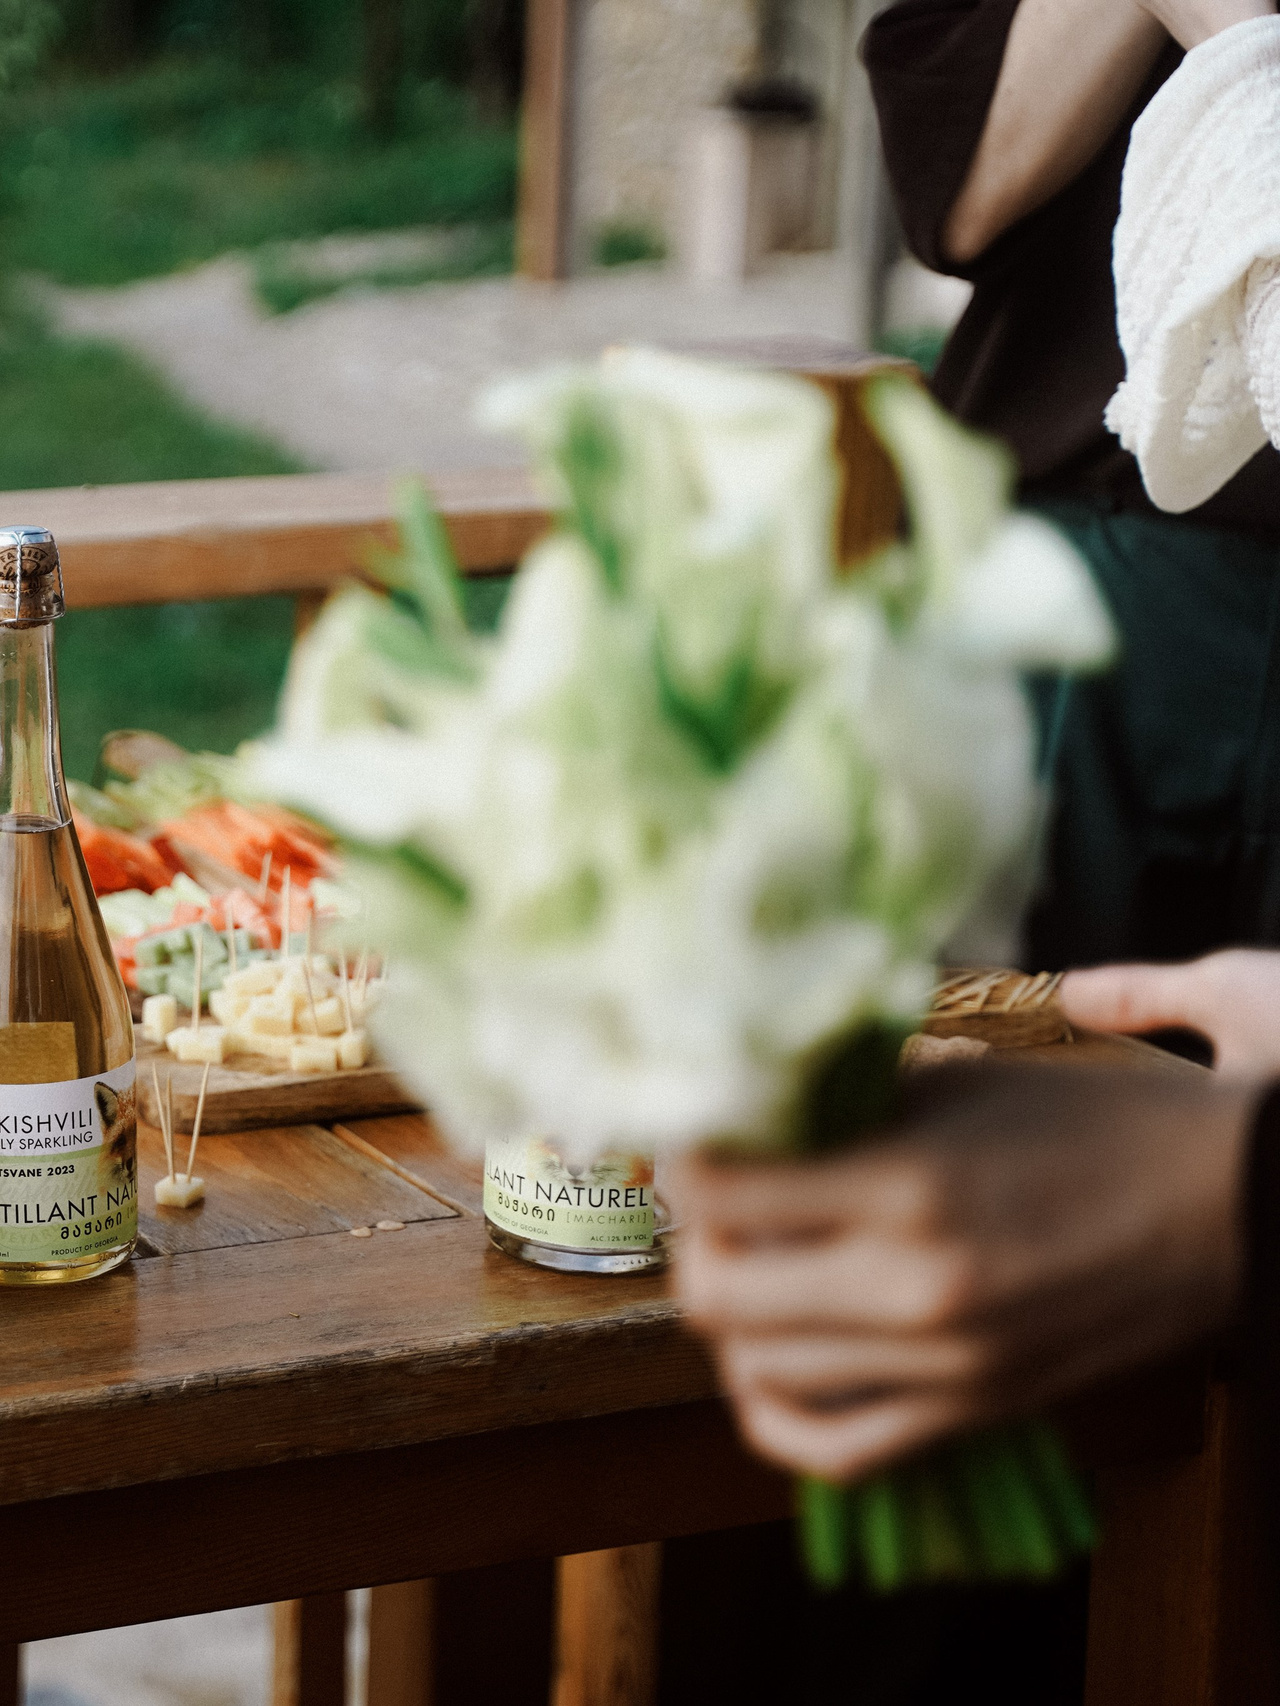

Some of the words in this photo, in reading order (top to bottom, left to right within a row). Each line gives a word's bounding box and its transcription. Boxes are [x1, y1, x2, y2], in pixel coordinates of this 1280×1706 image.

[19, 1131, 93, 1149] SPARKLING
[47, 1164, 75, 1177] 2023
[535, 1180, 649, 1208] NATUREL
[498, 1192, 555, 1222] მაჭარი
[60, 1211, 122, 1240] მაჭარი
[566, 1212, 648, 1225] [MACHARI]
[520, 1223, 549, 1236] GEORGIA
[51, 1246, 83, 1256] PRODUCT
[84, 1243, 94, 1252] OF
[94, 1235, 119, 1250] GEORGIA
